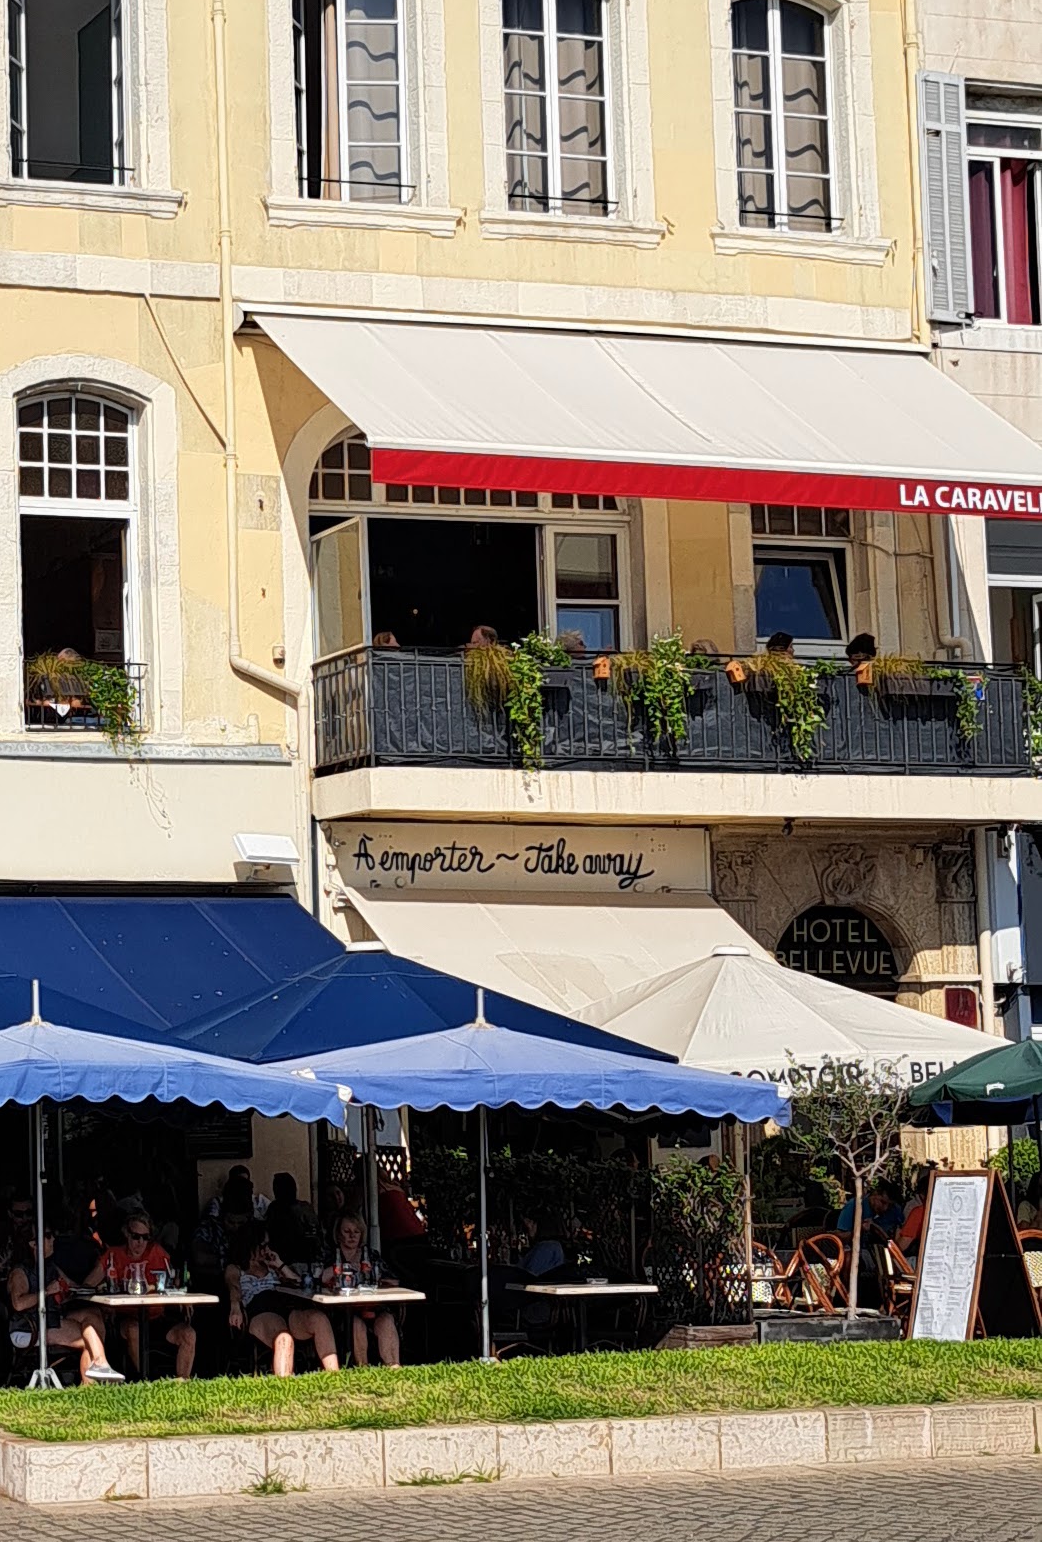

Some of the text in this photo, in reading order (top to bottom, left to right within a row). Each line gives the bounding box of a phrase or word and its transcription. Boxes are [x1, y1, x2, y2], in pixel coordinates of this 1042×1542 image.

[899, 483, 1042, 514] LA CARAVEL
[378, 839, 495, 884] emporter
[524, 837, 579, 875] Take
[582, 851, 655, 889] away
[793, 918, 878, 943] HOTEL
[776, 949, 892, 975] BELLEVUE
